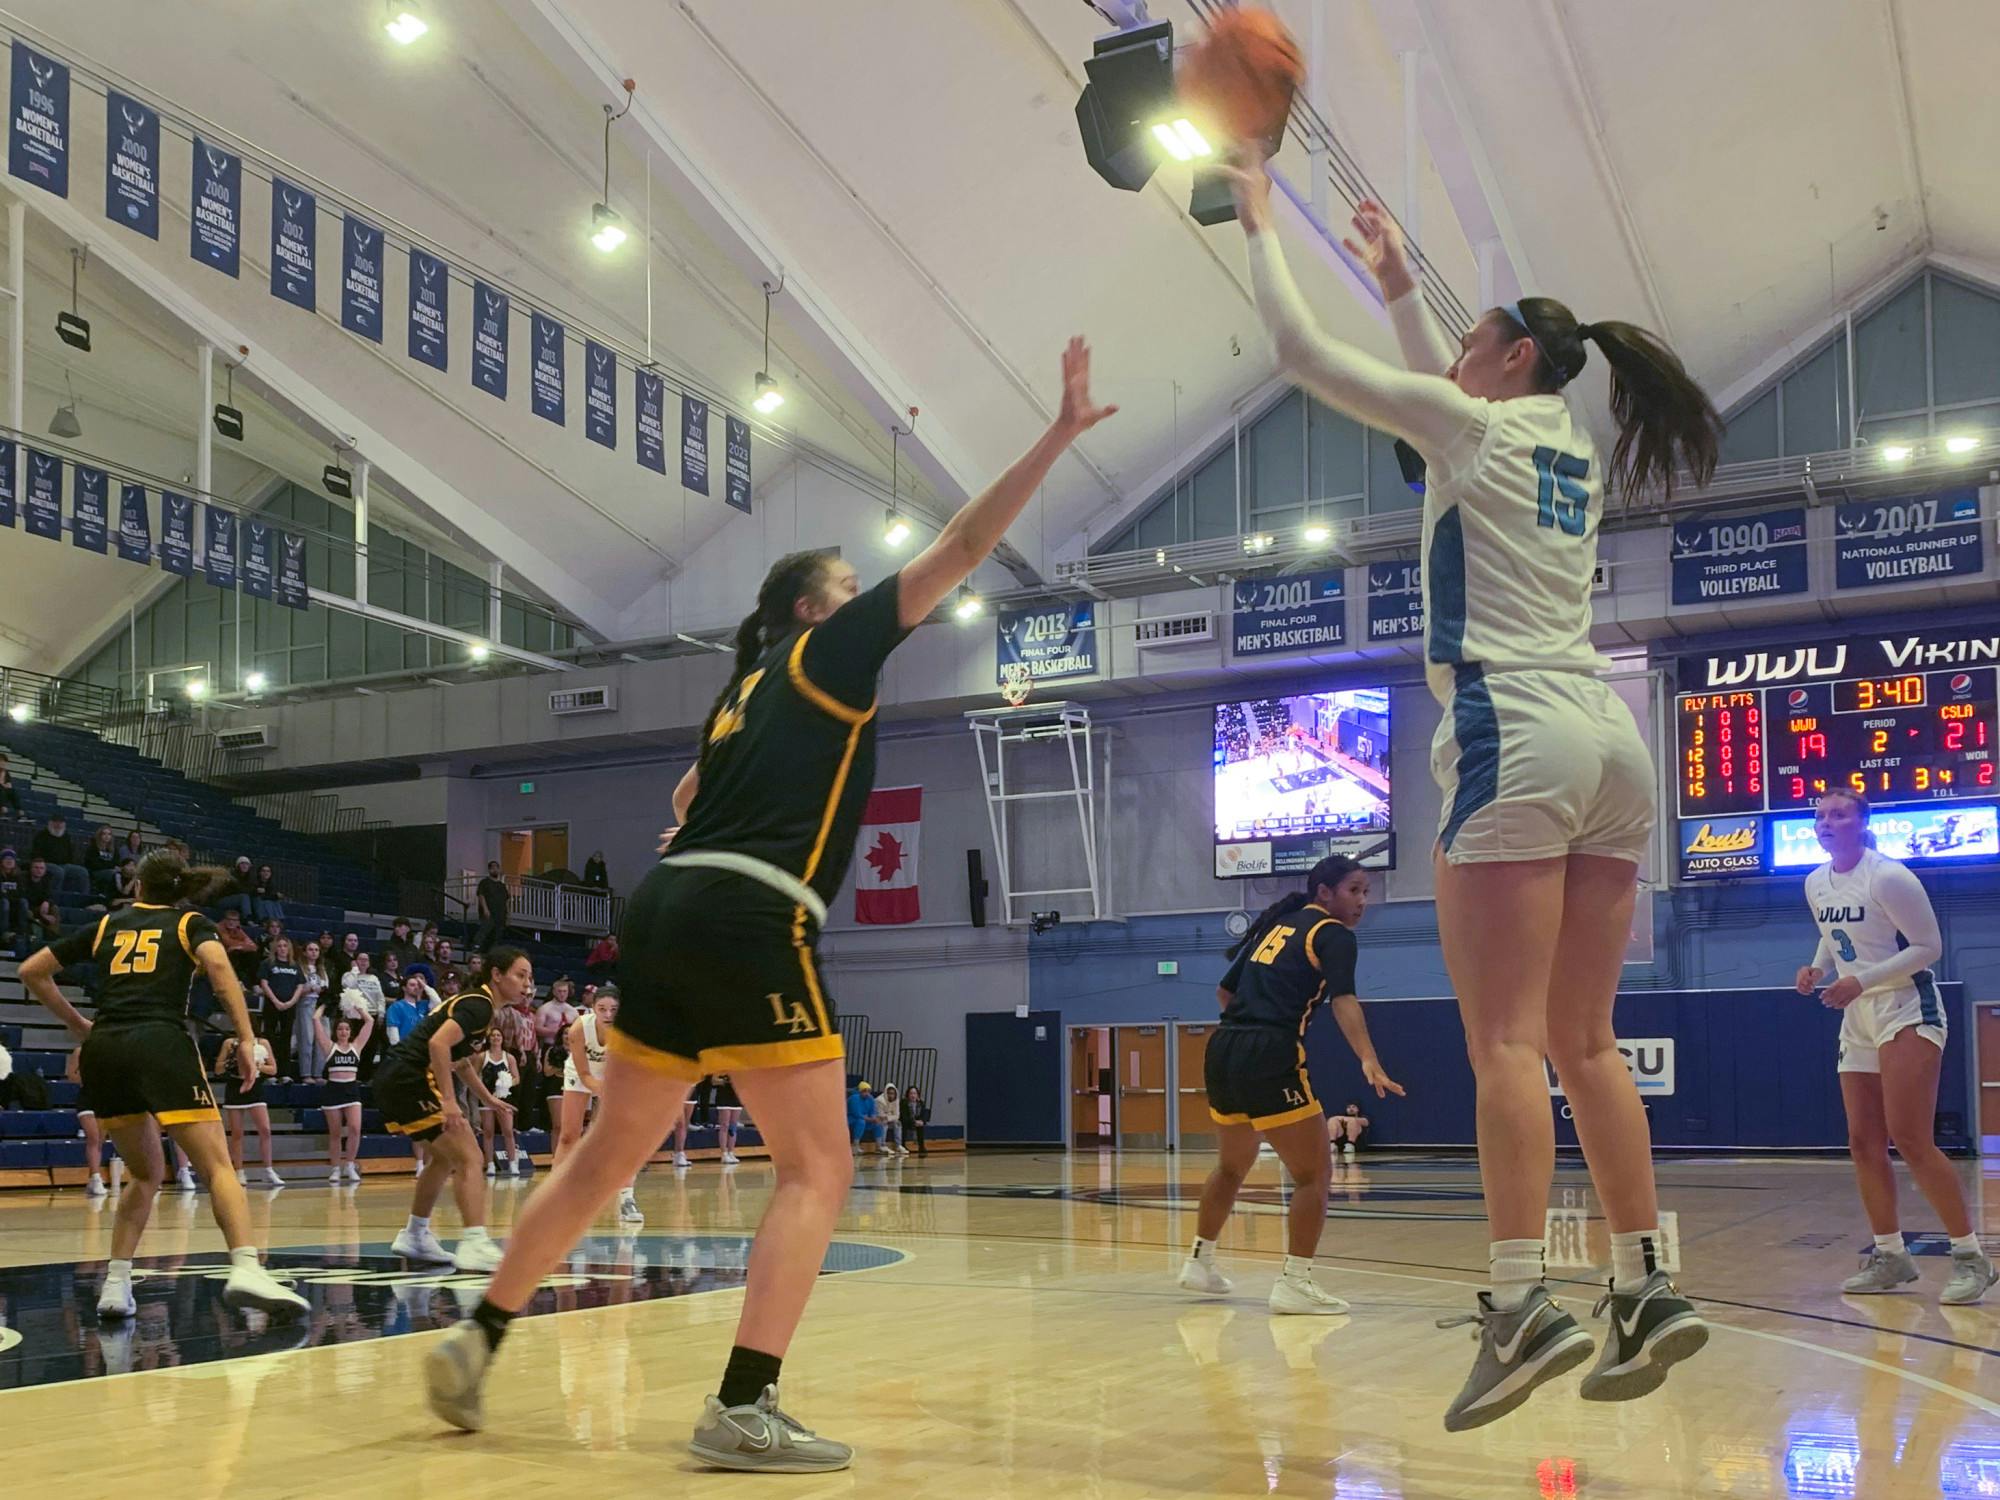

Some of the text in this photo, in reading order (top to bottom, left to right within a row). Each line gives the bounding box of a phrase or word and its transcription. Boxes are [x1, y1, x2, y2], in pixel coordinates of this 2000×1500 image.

[28, 88, 55, 116] 1996
[21, 105, 59, 135] WOMEN'S
[16, 117, 64, 151] BASKETBALL
[122, 135, 147, 161] 2000
[116, 152, 151, 179] WOMEN'S
[112, 163, 155, 194] BASKETBALL
[205, 178, 230, 203] 2000
[201, 195, 232, 220] WOMEN'S
[196, 206, 236, 235] BASKETBALL
[283, 218, 304, 241] 2002
[280, 234, 308, 257] WOMEN'S
[276, 244, 312, 271] BASKETBALL
[354, 253, 374, 275] 2006
[350, 268, 377, 290] WOMEN'S
[346, 278, 380, 304] BASKETBALL
[416, 300, 442, 321] WOMEN'S
[413, 310, 444, 334] BASKETBALL
[478, 331, 502, 351] WOMEN'S
[475, 340, 505, 364] BASKETBALL
[534, 368, 562, 390] BASKETBALL
[538, 360, 560, 379] WOMEN'S
[588, 395, 614, 416] BASKETBALL
[591, 387, 611, 404] WOMEN'S
[638, 422, 663, 441] BASKETBALL
[641, 414, 661, 430] WOMEN'S
[684, 445, 706, 464] BASKETBALL
[686, 436, 704, 453] WOMEN'S
[728, 442, 748, 462] 2023
[727, 464, 750, 483] BASKETBALL
[728, 457, 748, 473] WOMEN'S
[35, 490, 52, 501] MEN'S
[1532, 445, 1590, 537] 15
[82, 504, 98, 515] MEN'S
[1873, 500, 1938, 539] 2007
[124, 520, 138, 529] MEN'S
[170, 530, 184, 540] MEN'S
[214, 543, 228, 553] MEN'S
[1709, 521, 1768, 557] 1990
[1842, 535, 1978, 559] NATIONAL RUNNER UP
[251, 554, 265, 564] MEN'S
[1704, 559, 1777, 575] THIRD PLACE
[1866, 553, 1954, 580] VOLLEYBALL
[286, 570, 299, 580] MEN'S
[1700, 573, 1781, 597] VOLLEYBALL
[1263, 580, 1312, 613] 2001
[1024, 612, 1066, 642] 2013
[1261, 615, 1317, 629] FINAL FOUR
[1372, 617, 1409, 635] MEN'S
[1238, 625, 1342, 651] MEN'S BASKETBALL
[1020, 645, 1071, 657] FINAL FOUR
[1000, 654, 1093, 678] MEN'S BASKETBALL
[1707, 644, 1847, 686] WWU
[1685, 693, 1754, 711] PLY FL PTS
[1858, 677, 1922, 709] 3:40
[1698, 708, 1759, 727] 1 0 0
[1940, 704, 1974, 719] CSLA
[1791, 718, 1817, 732] WWU
[1863, 719, 1896, 728] PERIOD
[1694, 726, 1759, 745] 3 0 4
[1800, 733, 1826, 759] 19
[1873, 731, 1888, 753] 2
[1947, 722, 1985, 749] 21
[1688, 743, 1759, 762] 12 0 0
[1860, 757, 1901, 769] LAST SET
[1965, 750, 1988, 760] WON
[1689, 760, 1760, 779] 13 0 0
[1778, 766, 1799, 775] WON
[1915, 768, 1952, 790] 3 4
[1979, 763, 1993, 784] 2
[1689, 777, 1760, 796] 15 1 6
[1792, 778, 1826, 798] 3 4
[1851, 772, 1889, 794] 5 1
[1932, 789, 1958, 797] T.O.L.
[1236, 857, 1268, 871] BioLife
[1688, 856, 1760, 869] AUTO GLASS
[1818, 906, 1865, 923] WWU
[110, 929, 163, 975] 25
[1250, 924, 1296, 965] 15
[1831, 928, 1857, 962] 3
[766, 993, 819, 1035] LA
[192, 1085, 211, 1105] LA
[1282, 1087, 1305, 1105] LA
